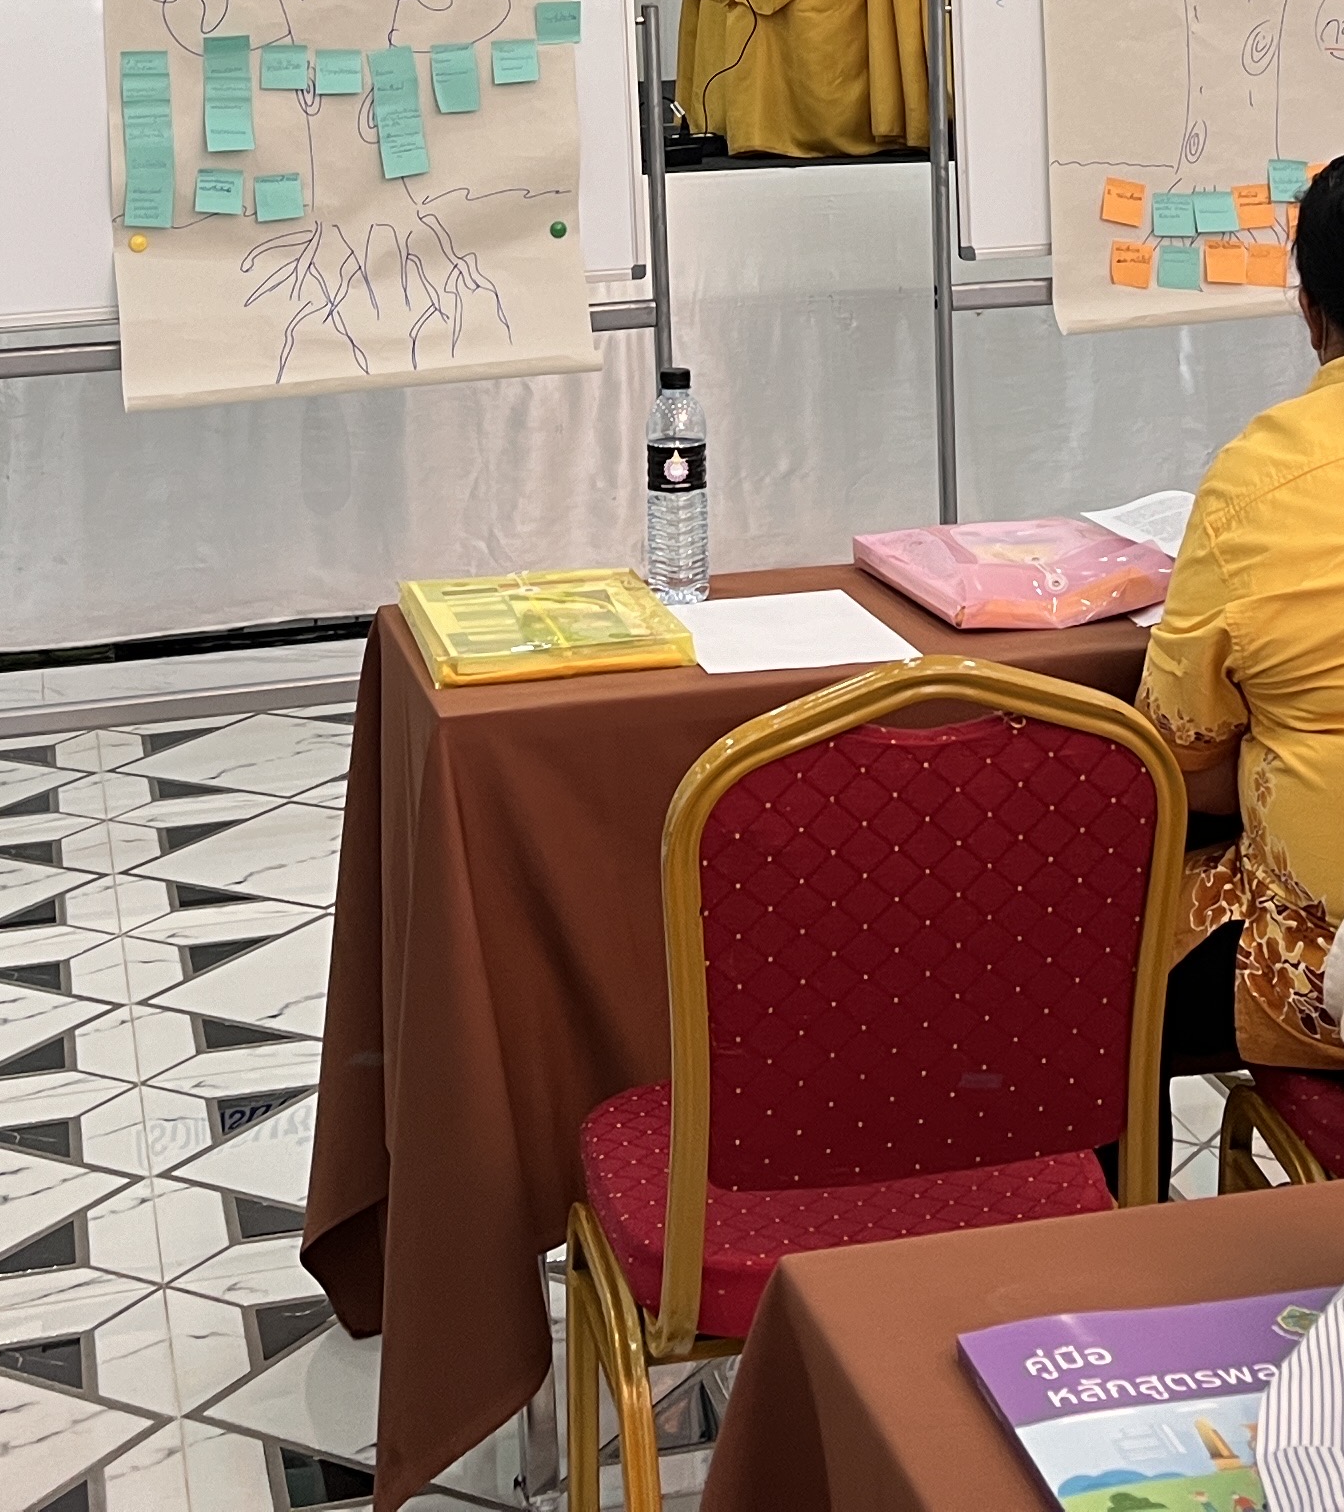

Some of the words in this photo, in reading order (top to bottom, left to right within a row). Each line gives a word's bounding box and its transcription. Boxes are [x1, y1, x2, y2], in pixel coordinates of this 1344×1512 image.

[1024, 1345, 1113, 1381] คู่มือ
[1046, 1361, 1280, 1409] หลักสูตรพล
